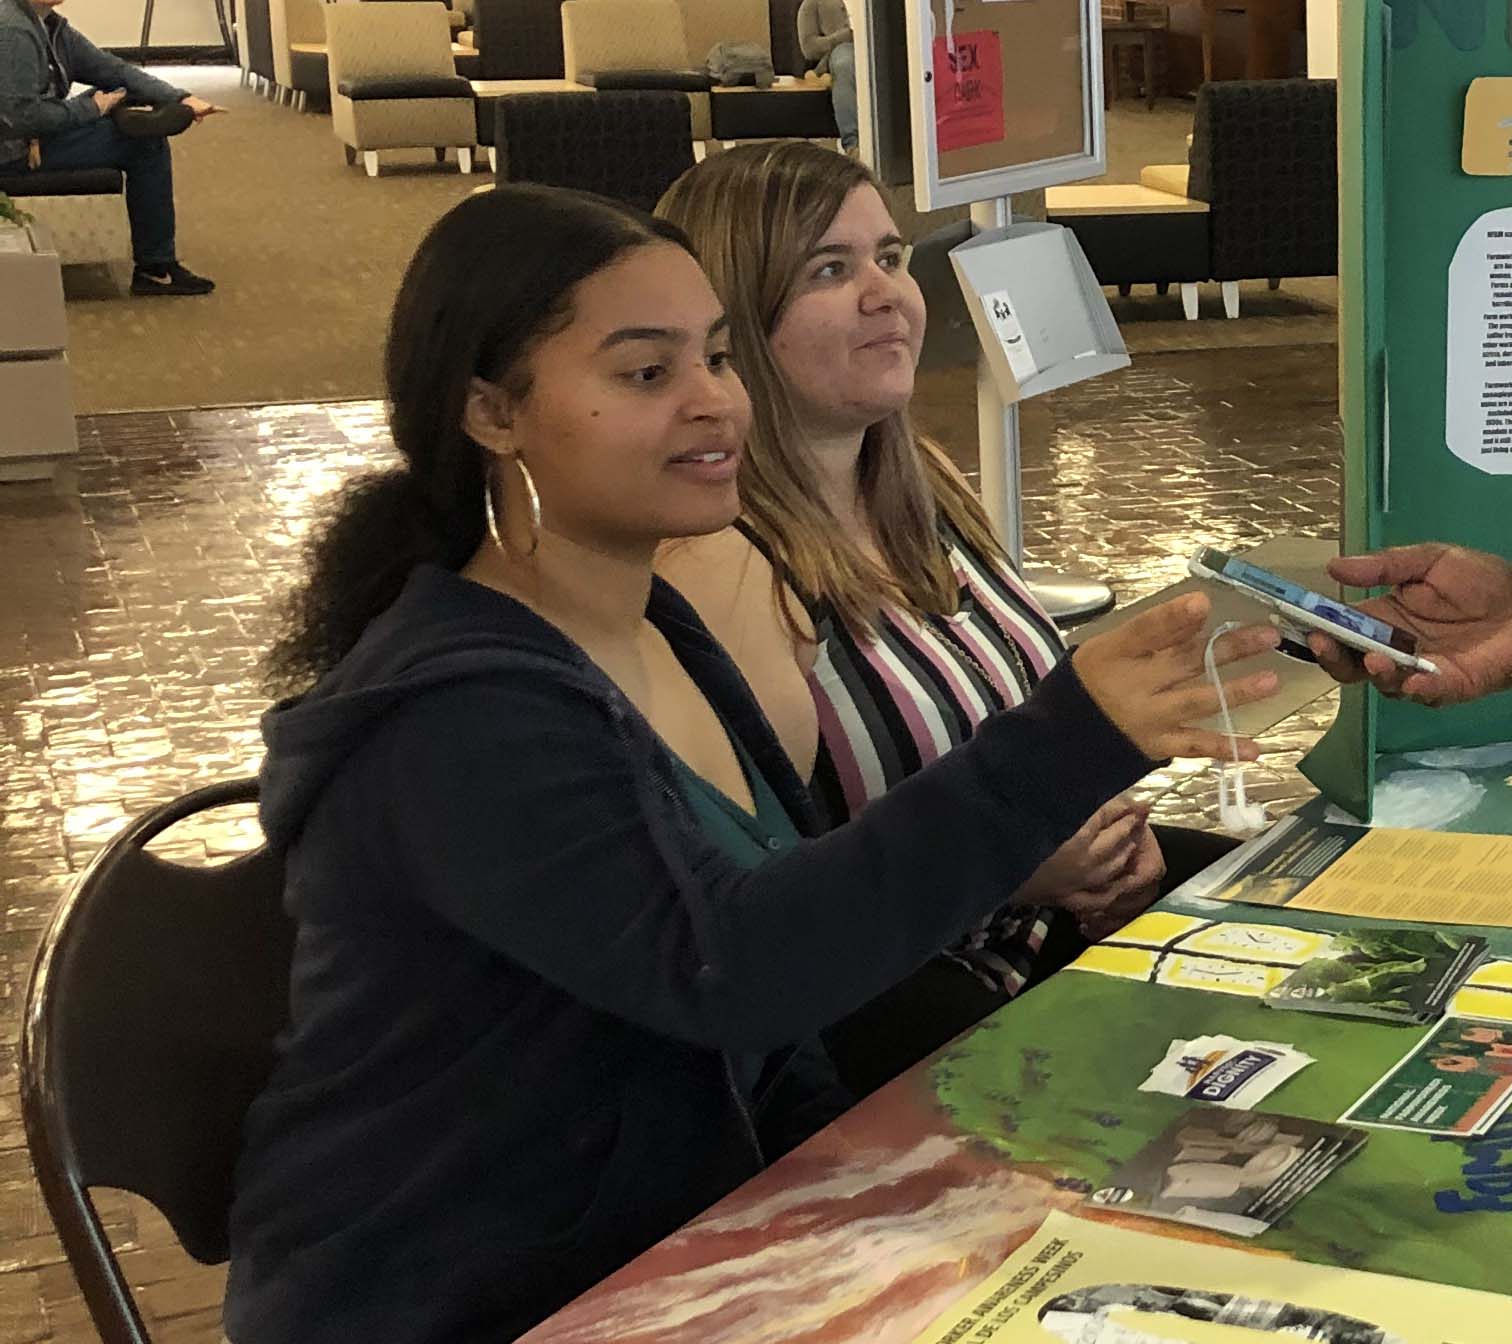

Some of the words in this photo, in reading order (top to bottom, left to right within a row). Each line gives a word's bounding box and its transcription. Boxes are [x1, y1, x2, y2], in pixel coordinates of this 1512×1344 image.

[1203, 1054, 1261, 1096] DIGNITY
[972, 1264, 1040, 1319] AWARENESS
[1032, 1237, 1069, 1265] WEEK
[982, 1323, 999, 1339] DE
[998, 1306, 1020, 1323] LOS
[1014, 1251, 1083, 1306] CAMPESINOS
